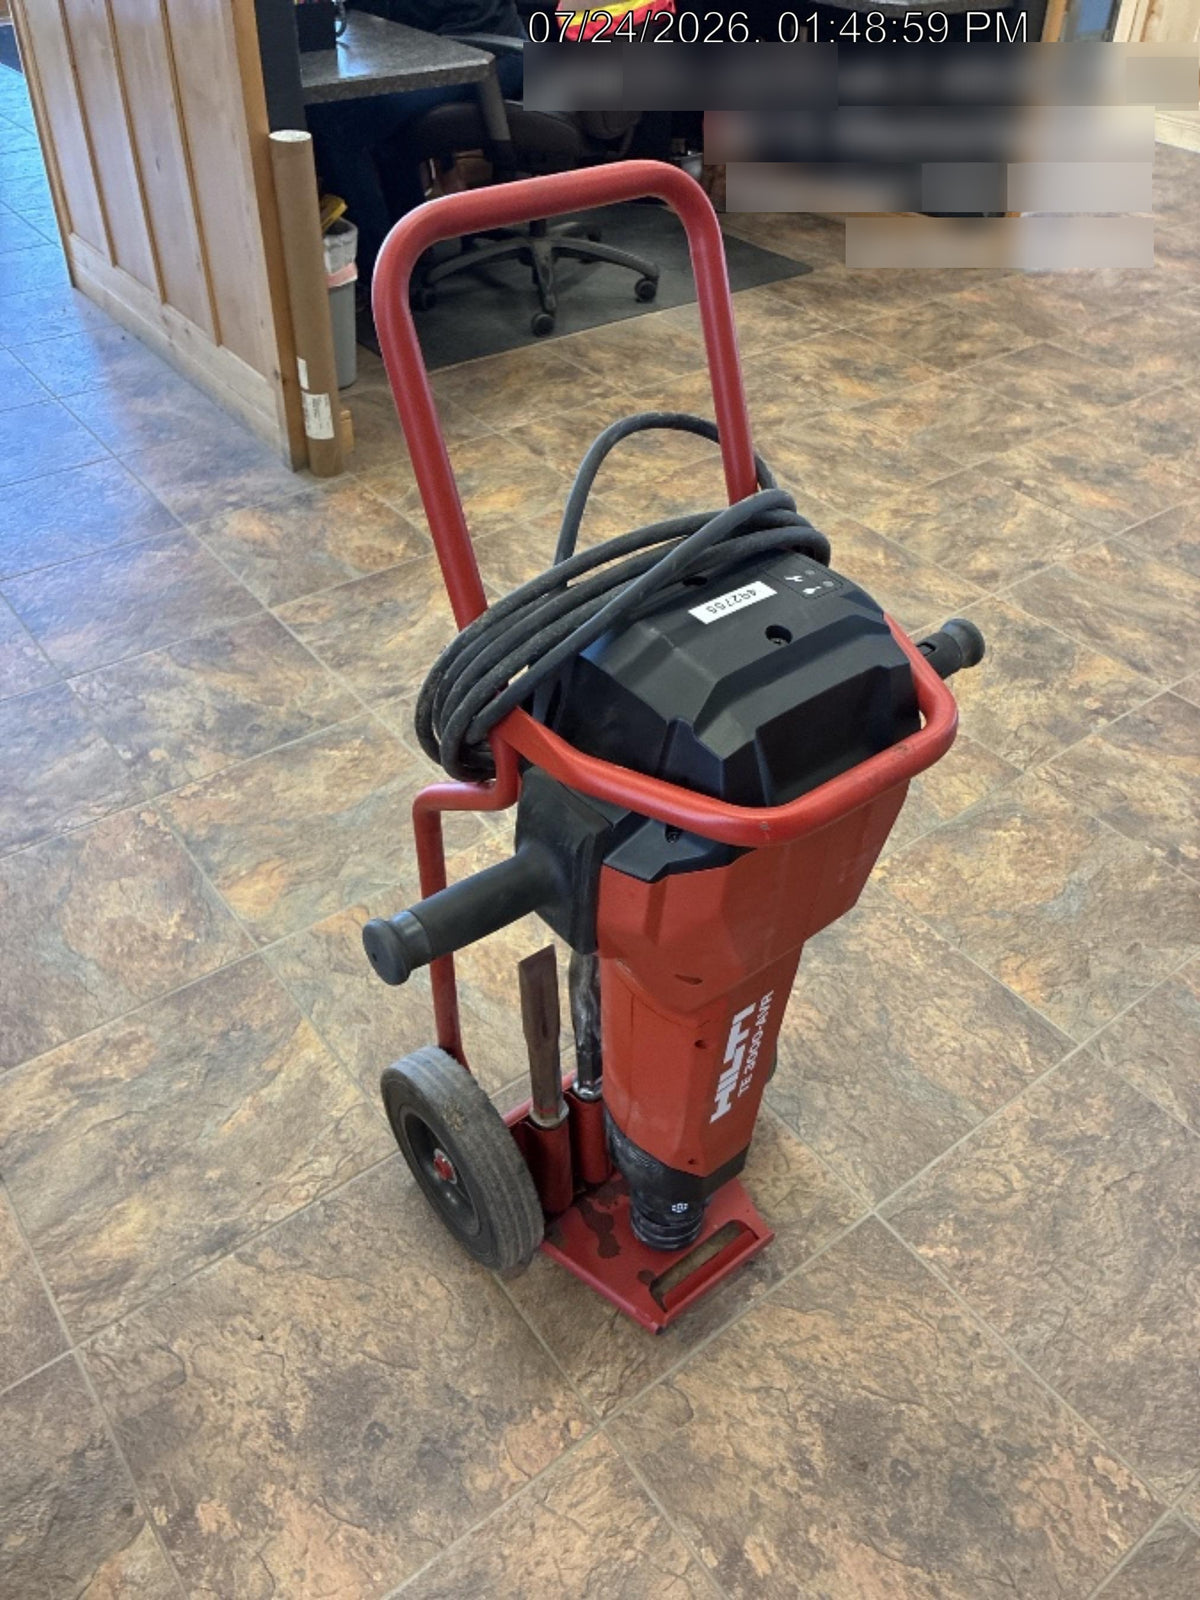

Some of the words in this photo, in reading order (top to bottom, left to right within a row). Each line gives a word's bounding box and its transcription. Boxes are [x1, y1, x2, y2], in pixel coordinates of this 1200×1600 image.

[709, 1002, 757, 1124] HILTI
[744, 989, 775, 1075] 3000-AVR
[737, 1073, 753, 1098] TE
